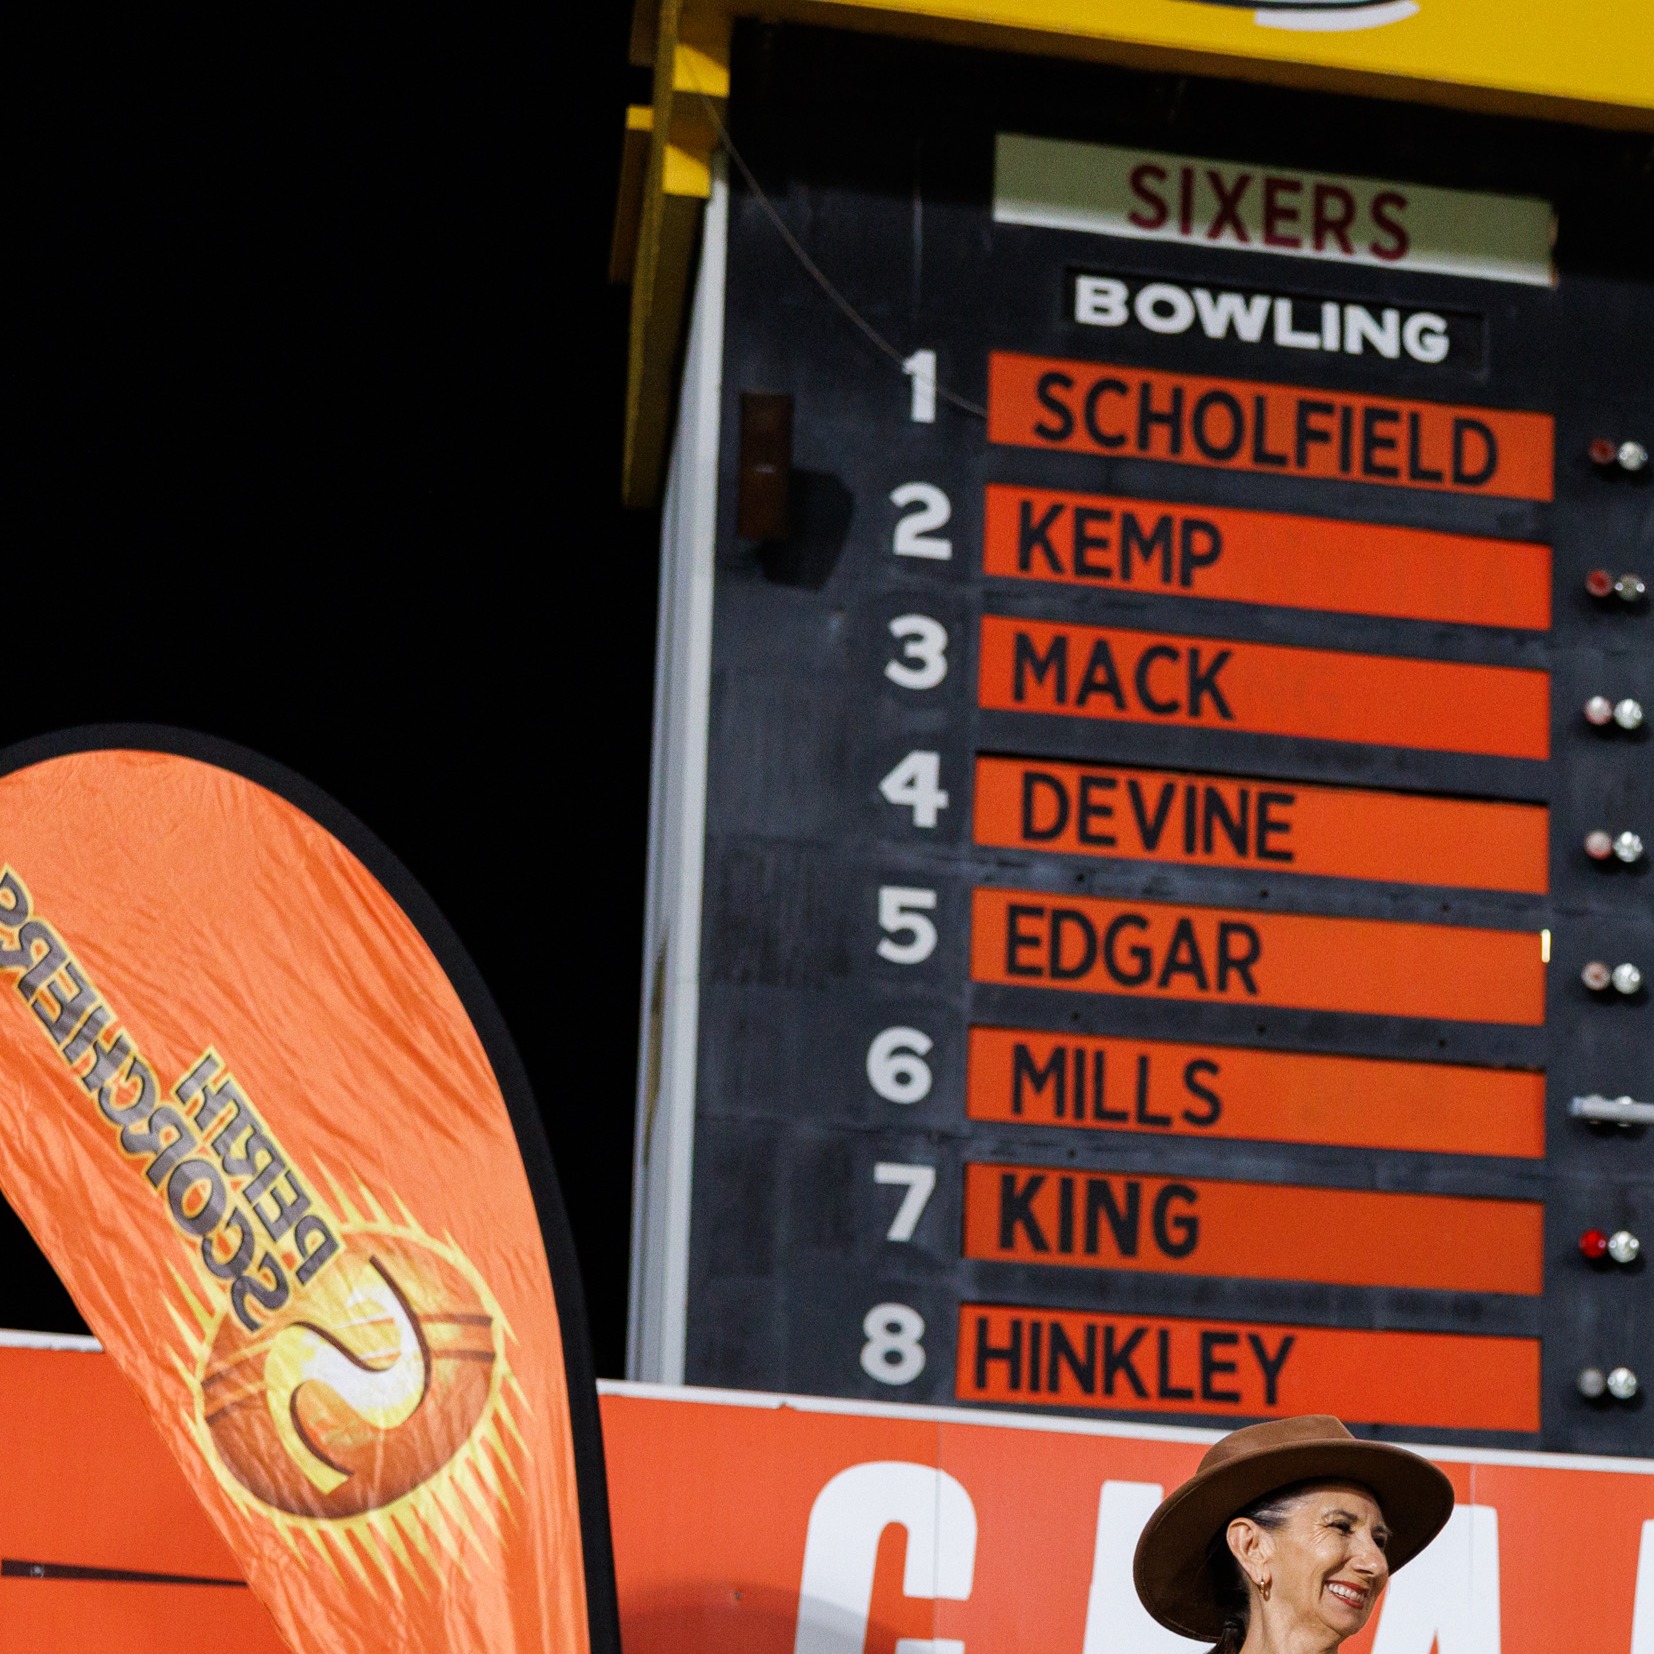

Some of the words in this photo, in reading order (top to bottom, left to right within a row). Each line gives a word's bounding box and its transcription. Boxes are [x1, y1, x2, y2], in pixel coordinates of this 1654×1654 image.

[1128, 163, 1410, 262] SIXERS
[1075, 275, 1449, 363] BOWLING
[902, 350, 935, 423] 1
[1034, 371, 1498, 486] SCHOLFIELD
[890, 483, 952, 559] 2
[1018, 501, 1220, 588] KEMP
[884, 614, 948, 689] 3
[1013, 634, 1237, 721] MACK
[879, 751, 948, 827] 4
[1022, 772, 1296, 862] DEVINE
[876, 886, 937, 964] 5
[1007, 906, 1261, 995] EDGAR
[866, 1026, 932, 1104] 6
[1012, 1044, 1222, 1127] MILLS
[874, 1163, 936, 1241] 7
[1000, 1173, 1199, 1259] KING
[860, 1303, 926, 1385] 8
[974, 1319, 1296, 1406] HINKLEY
